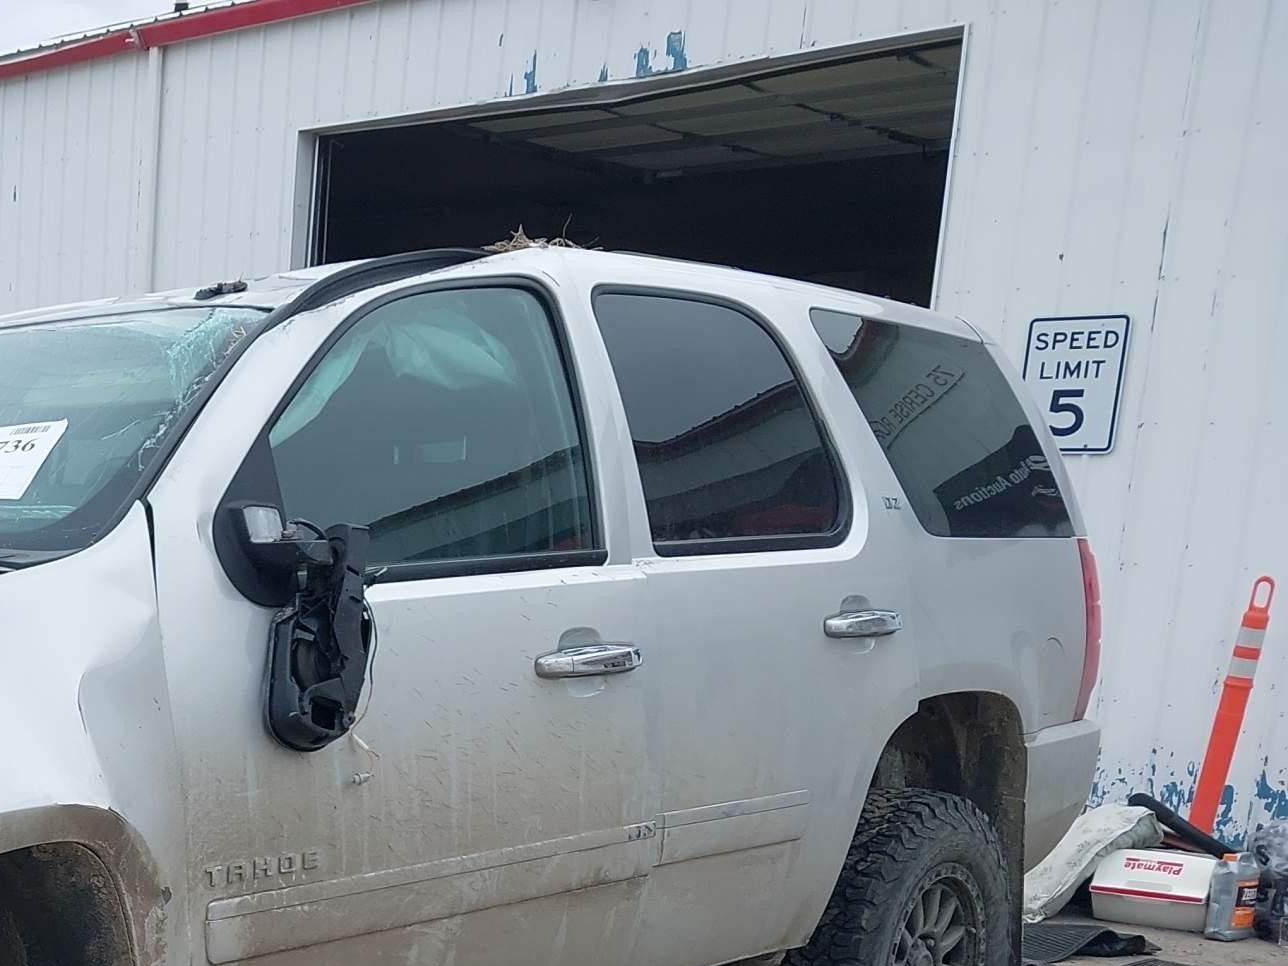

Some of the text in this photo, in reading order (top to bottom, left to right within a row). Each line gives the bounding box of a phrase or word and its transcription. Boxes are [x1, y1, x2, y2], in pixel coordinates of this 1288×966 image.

[1034, 329, 1120, 351] SPEED
[1039, 359, 1107, 380] LIMIT
[1048, 388, 1085, 437] 5
[205, 850, 320, 888] TAHOE
[1123, 861, 1183, 876] Playmate
